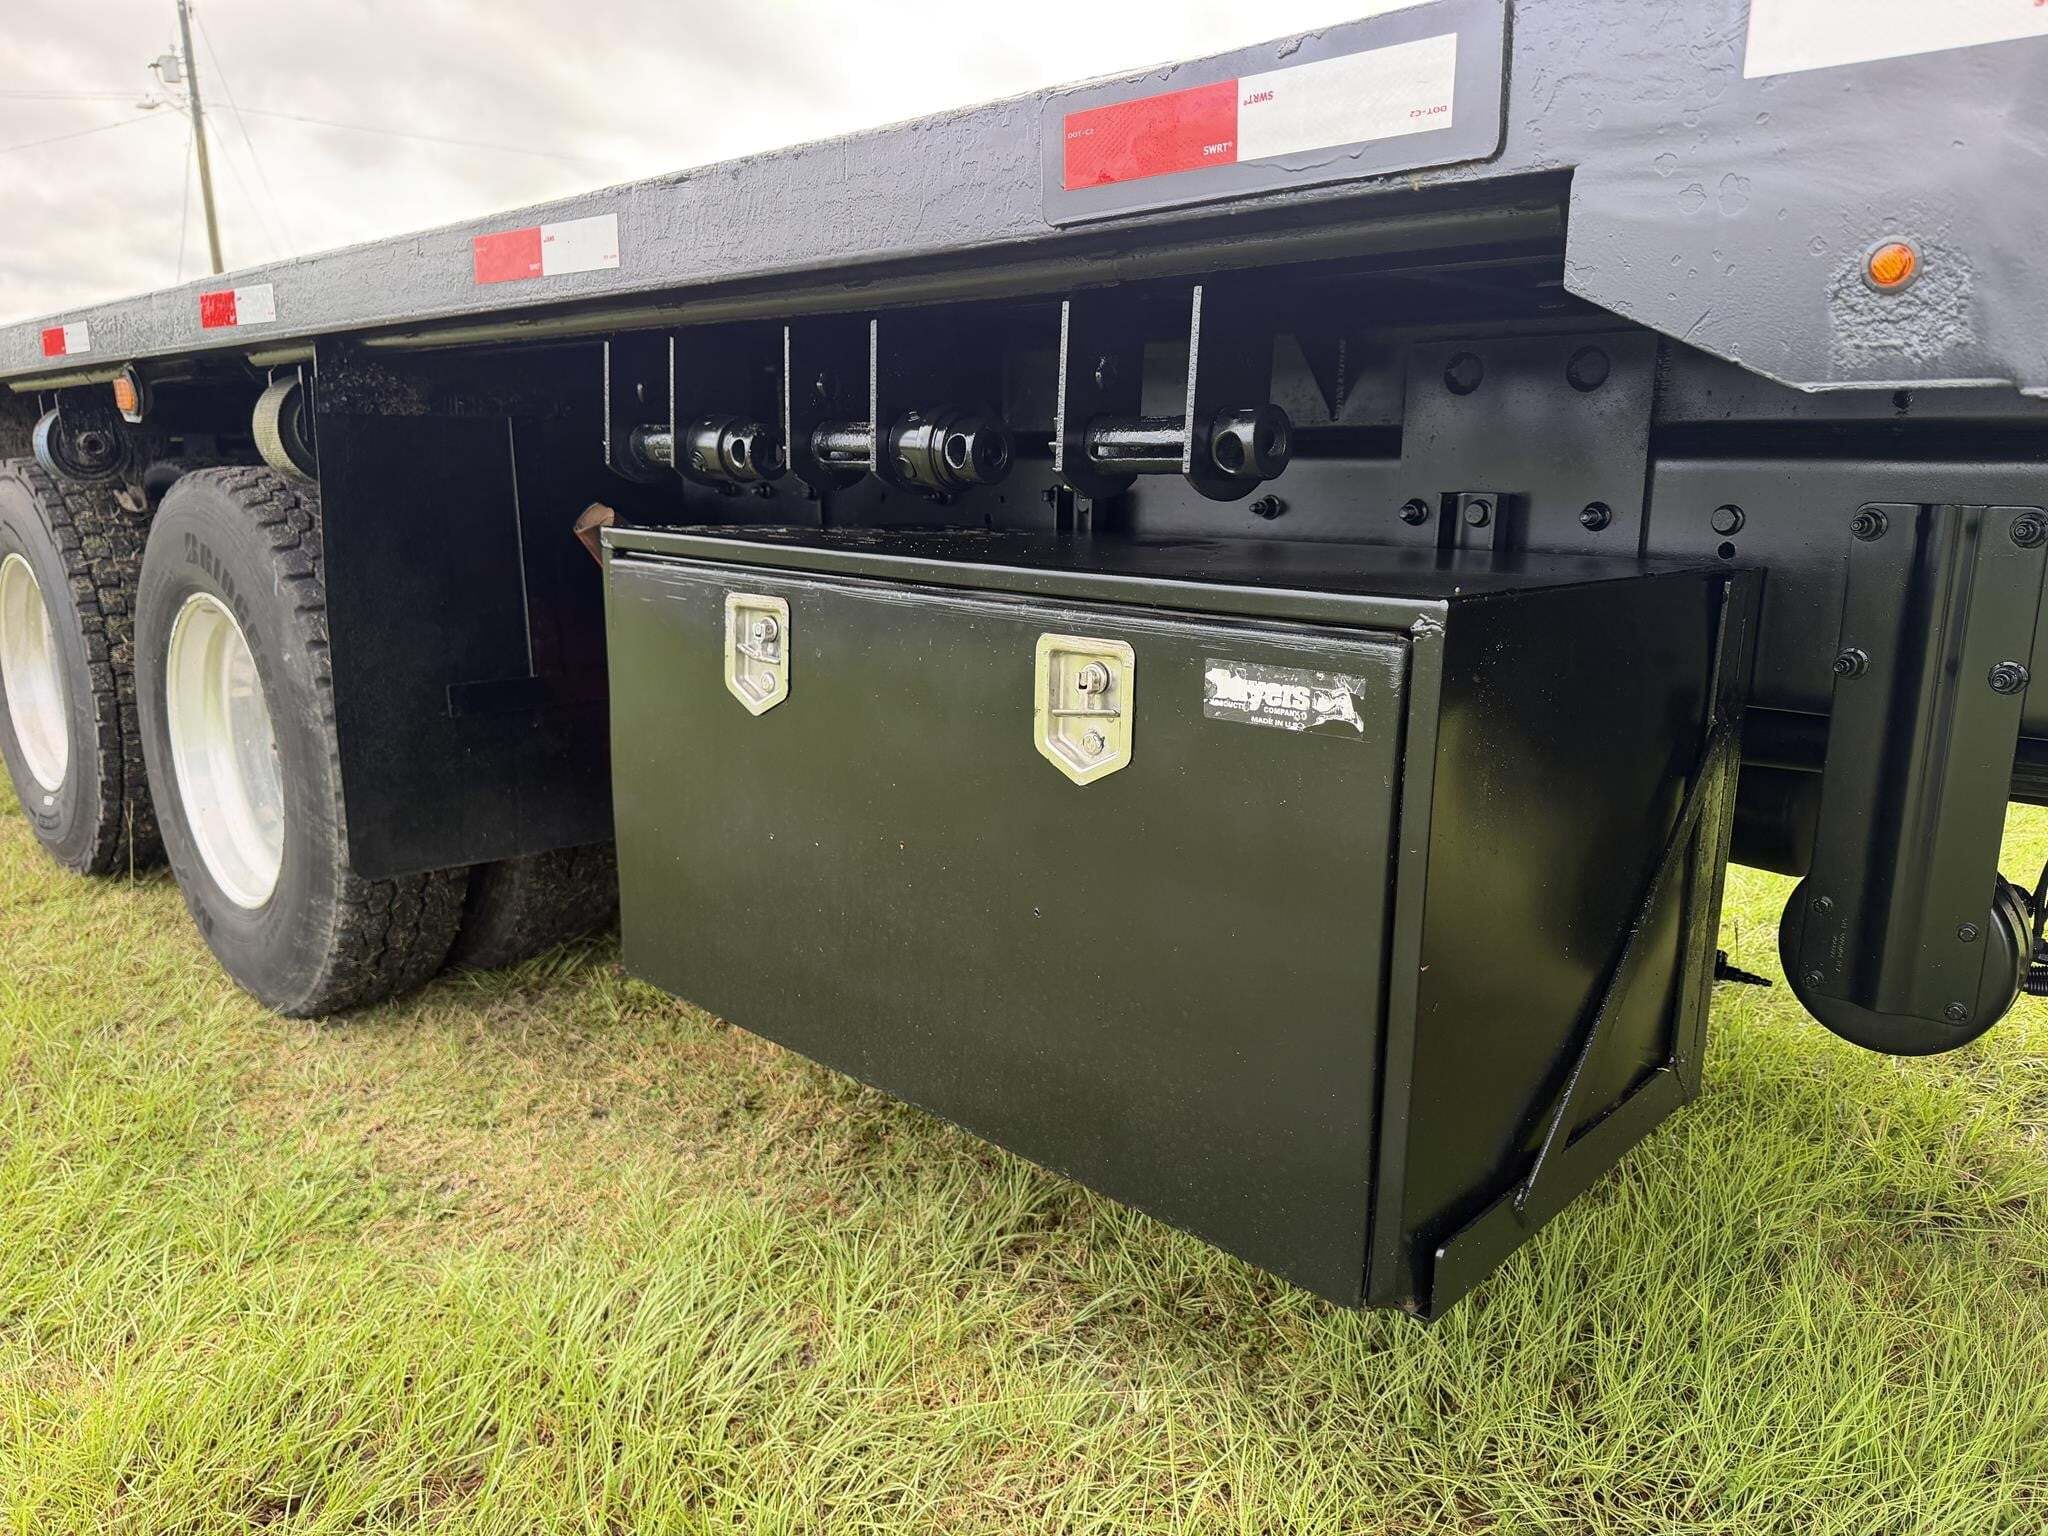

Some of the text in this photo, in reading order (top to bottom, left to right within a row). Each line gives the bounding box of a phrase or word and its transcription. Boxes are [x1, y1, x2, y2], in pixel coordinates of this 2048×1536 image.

[1409, 105, 1447, 118] DOT-C2
[1209, 668, 1311, 712] yers
[1251, 716, 1273, 725] MADE
[1275, 719, 1284, 727] IN
